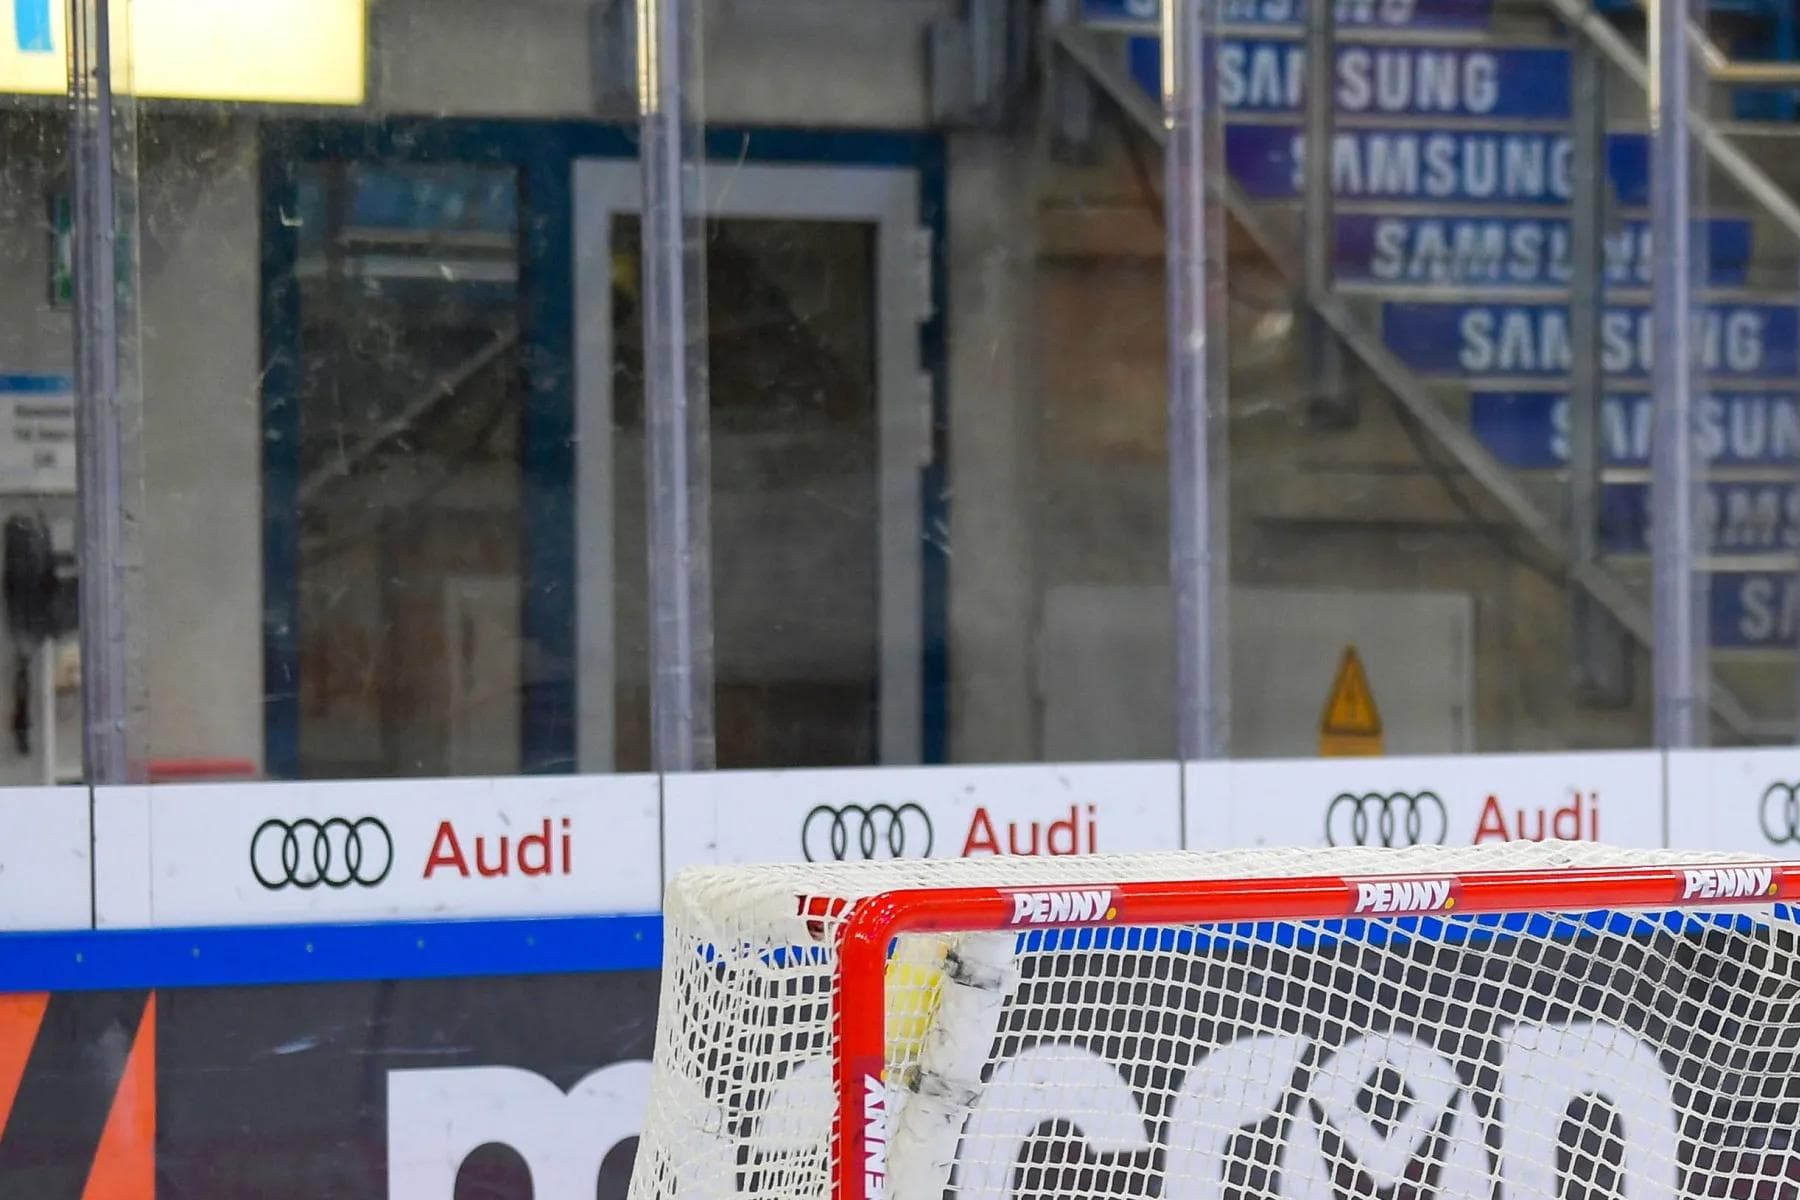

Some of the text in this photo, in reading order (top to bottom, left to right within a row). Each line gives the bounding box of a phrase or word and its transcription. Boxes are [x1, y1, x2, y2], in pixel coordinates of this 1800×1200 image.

[961, 804, 1097, 858] Audi
[1472, 793, 1601, 845] Audi
[422, 817, 572, 879] Audi
